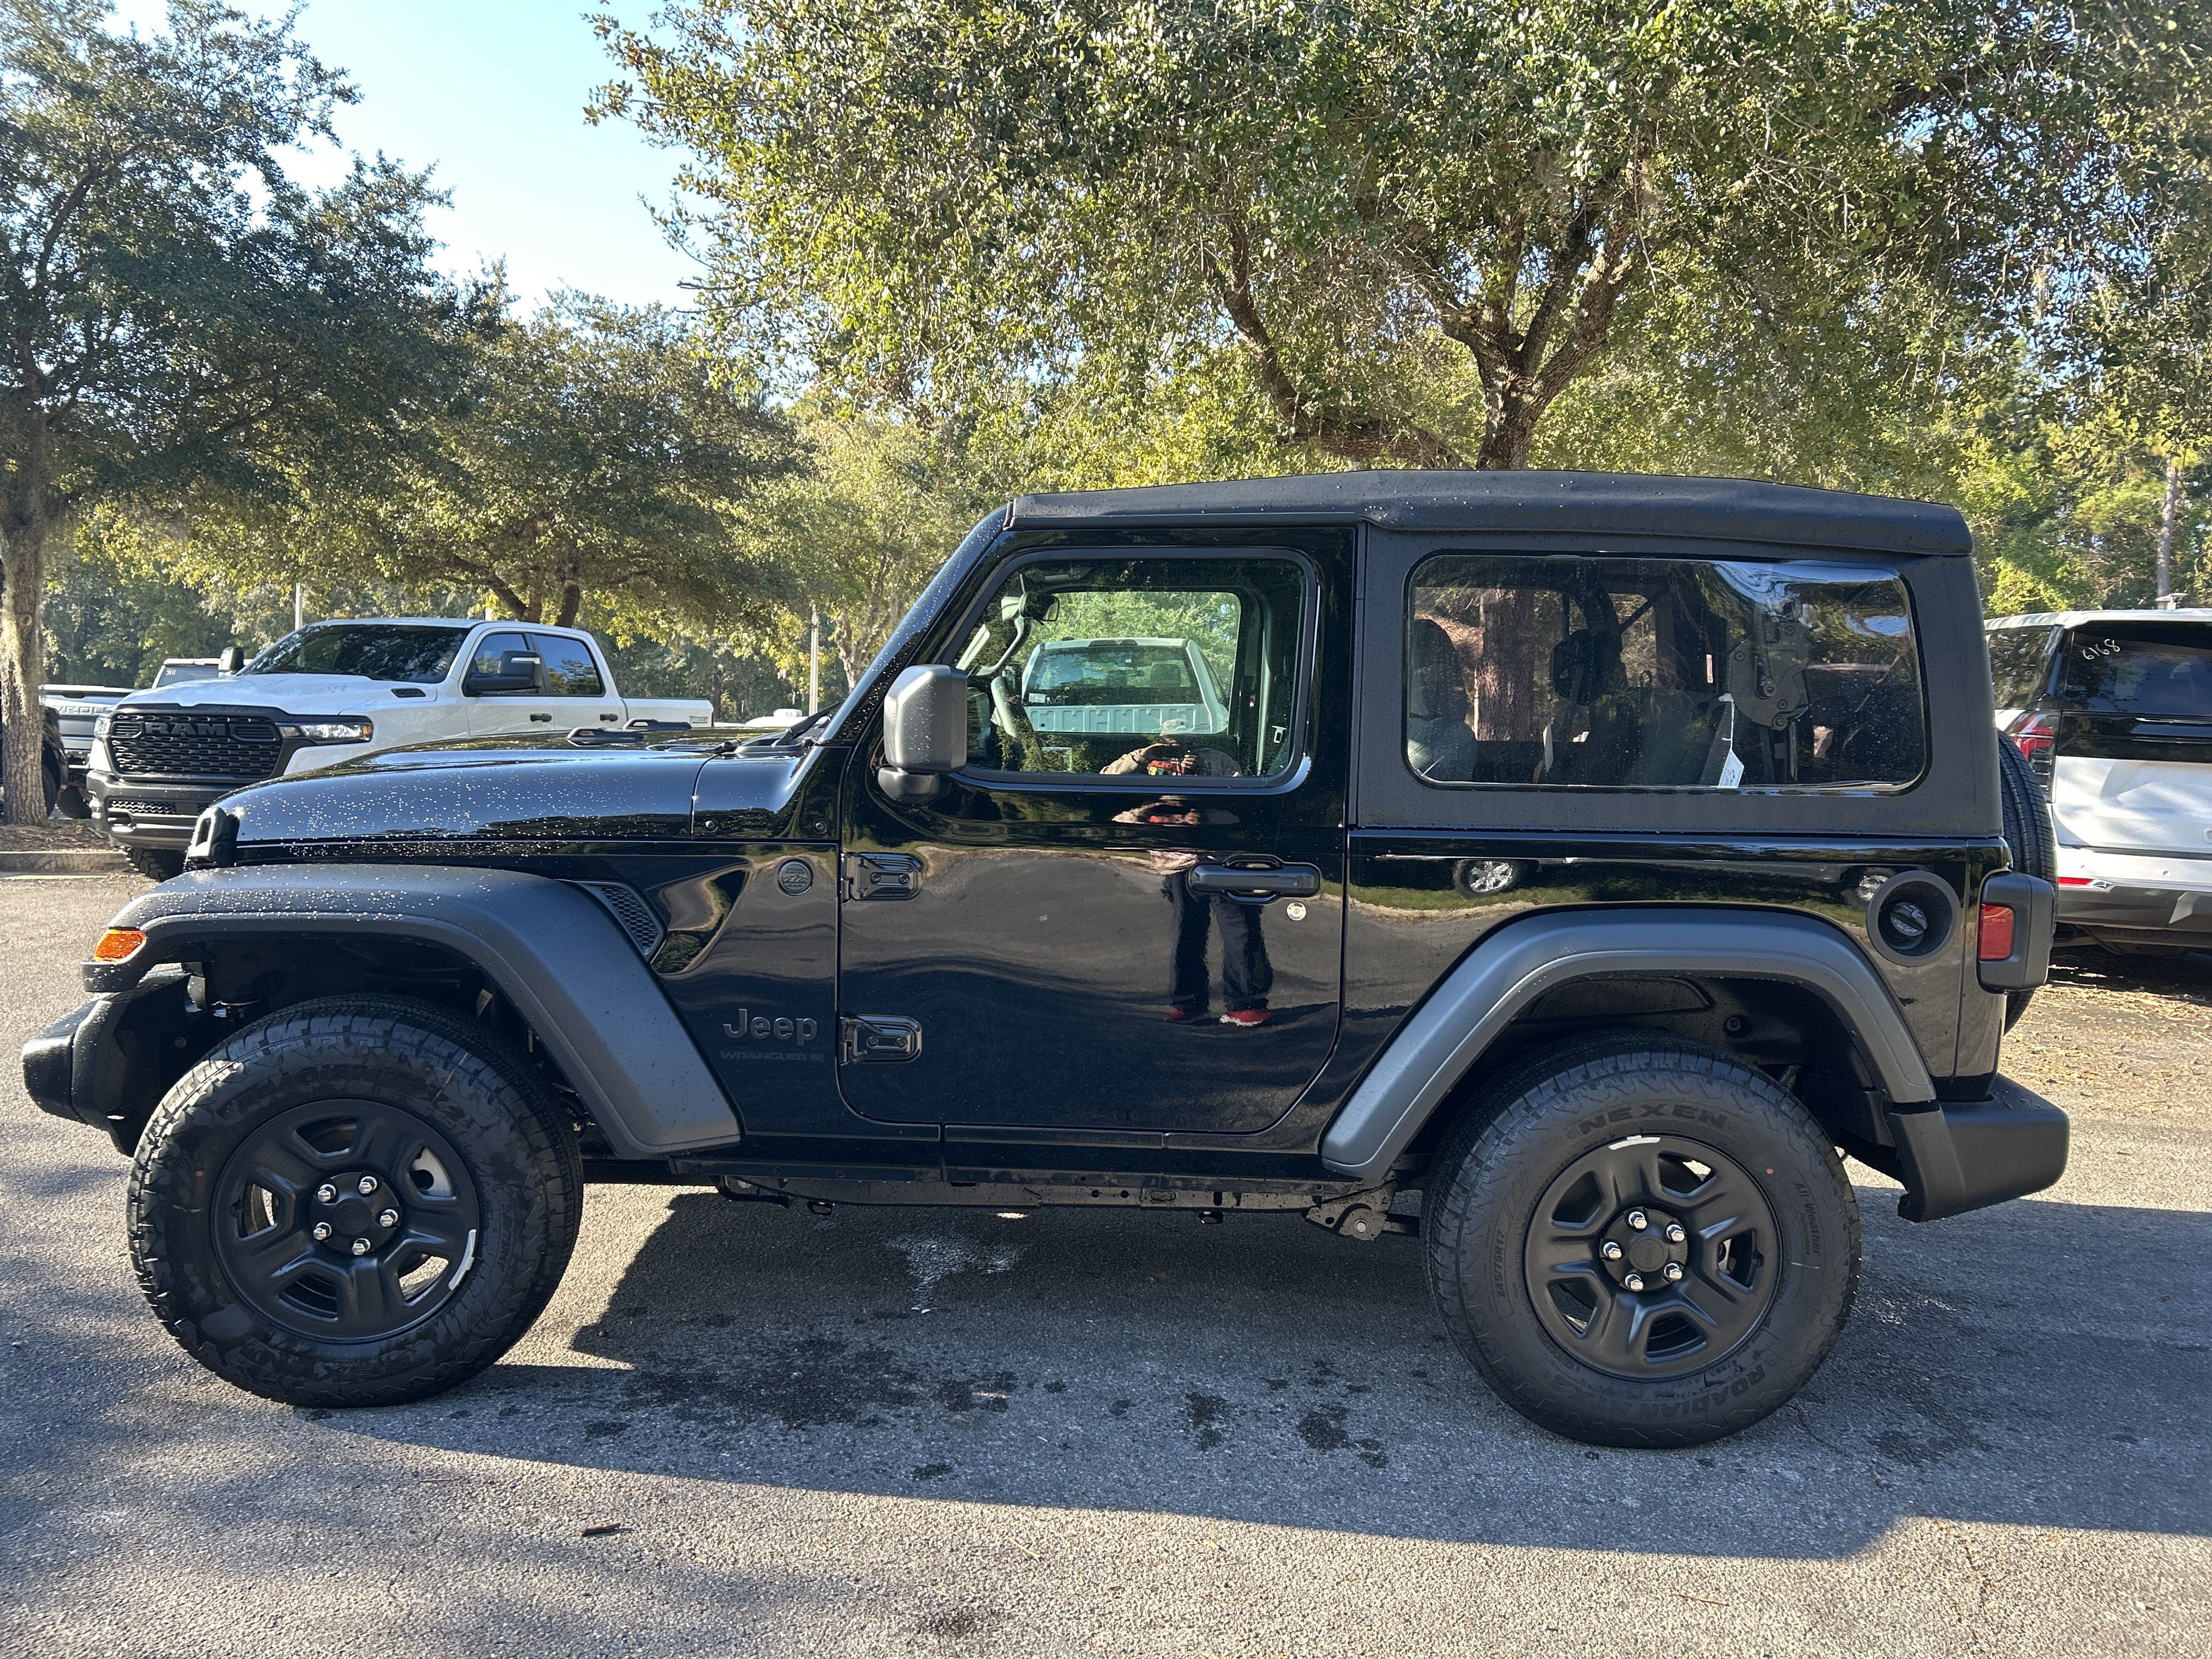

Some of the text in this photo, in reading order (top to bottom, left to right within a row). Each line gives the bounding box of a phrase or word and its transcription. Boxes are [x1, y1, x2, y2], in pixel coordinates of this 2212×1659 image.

[2082, 639, 2120, 660] 6168
[144, 721, 226, 736] RAM
[723, 1008, 818, 1047] Jeep
[719, 1049, 808, 1061] WRANGLER
[1579, 1103, 1728, 1135] NEXEN
[1792, 1181, 1822, 1257] All-Weather
[1493, 1229, 1506, 1299] 245/75R17
[1638, 1364, 1766, 1420] ROADIAN
